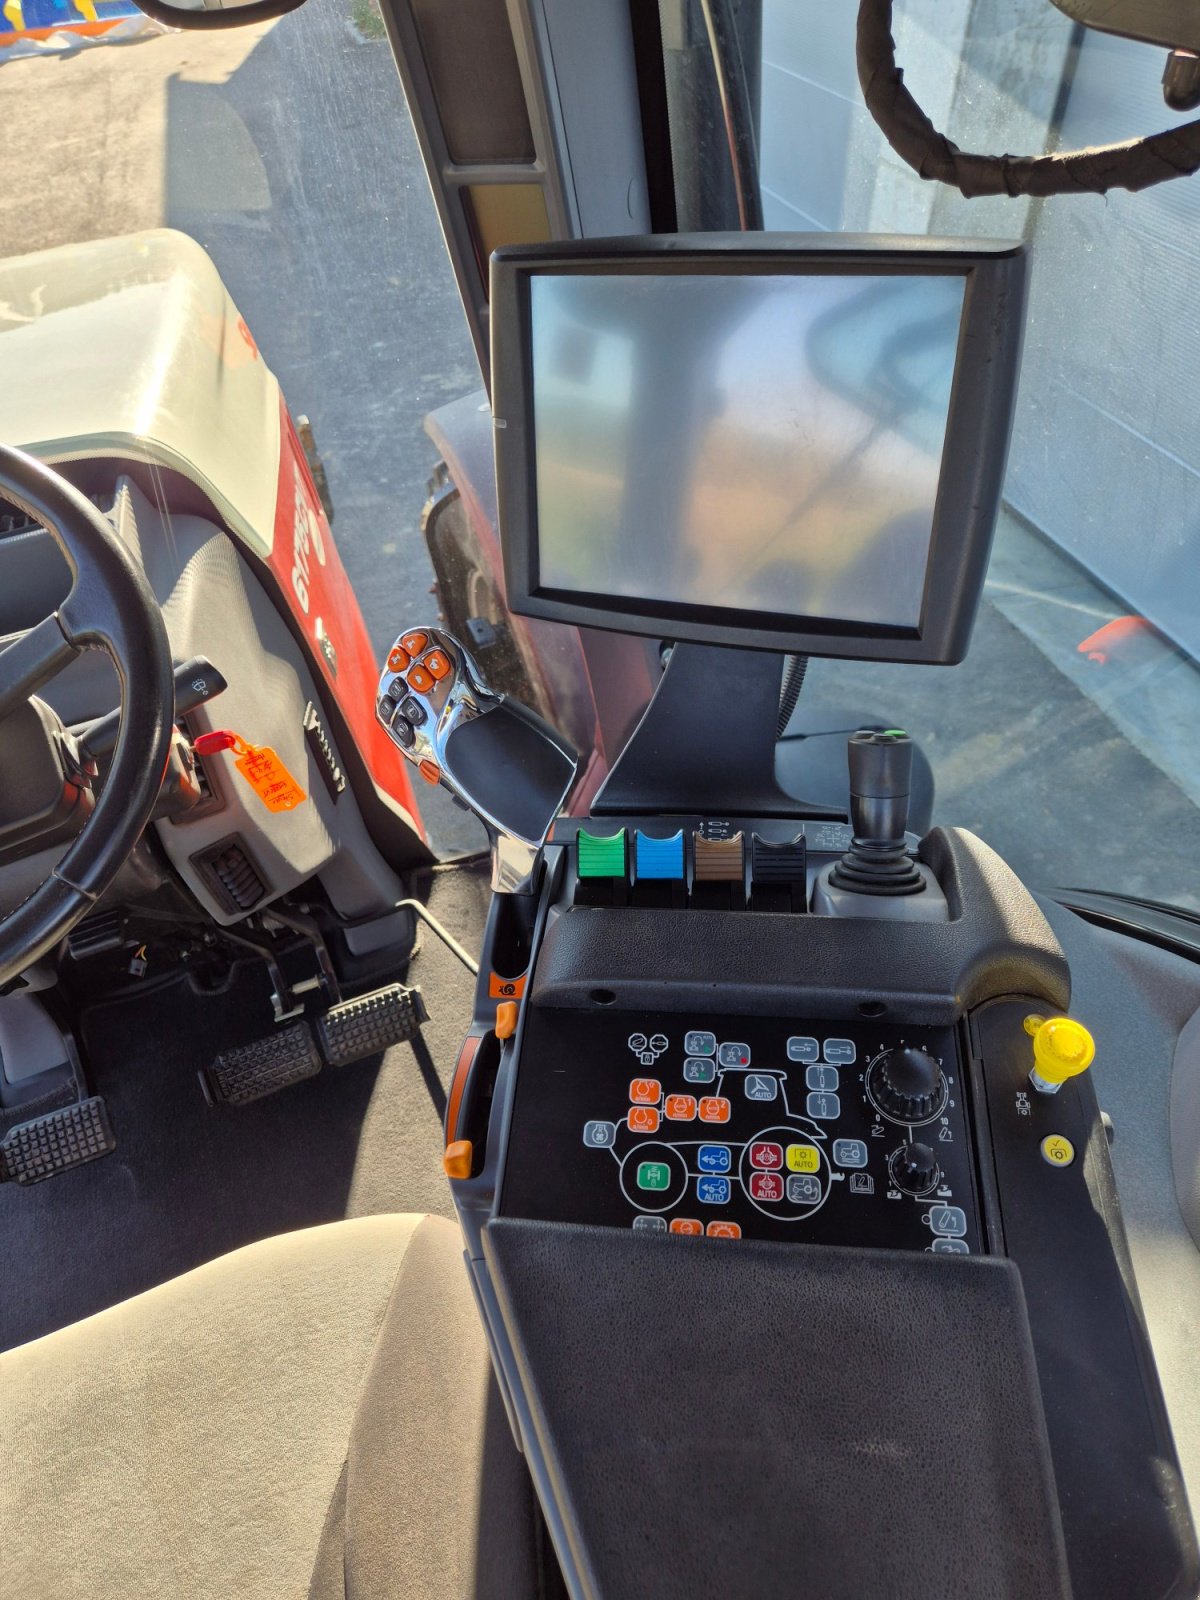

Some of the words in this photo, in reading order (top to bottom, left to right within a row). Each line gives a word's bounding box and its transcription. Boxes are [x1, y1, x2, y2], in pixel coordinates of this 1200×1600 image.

[865, 1055, 871, 1063] 3
[938, 1057, 944, 1066] 7
[858, 1073, 865, 1082] 2
[948, 1076, 954, 1085] 8
[754, 1091, 772, 1099] AUTO
[862, 1094, 867, 1103] 1
[720, 1100, 727, 1109] 2
[949, 1099, 955, 1108] 9
[875, 1113, 881, 1122] 0
[940, 1116, 949, 1126] 10
[793, 1160, 814, 1169] AUTO
[704, 1192, 725, 1202] AUTO
[757, 1189, 778, 1199] AUTO
